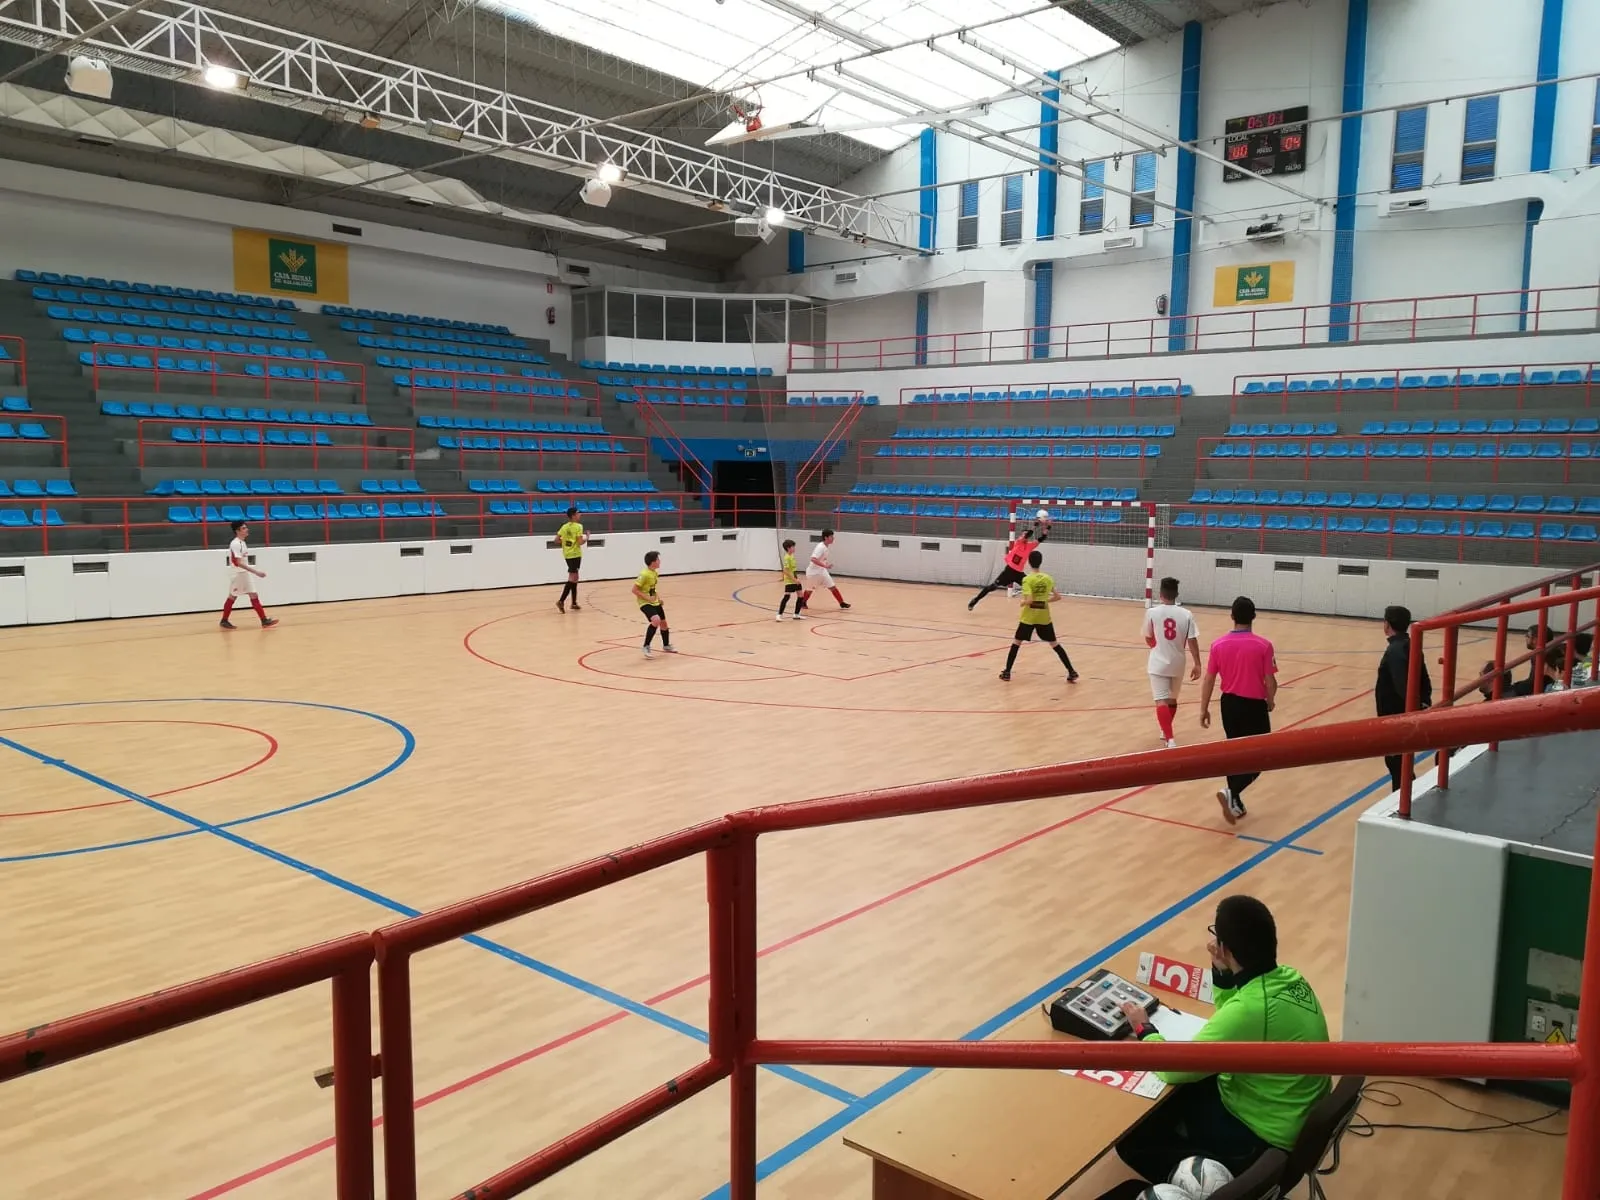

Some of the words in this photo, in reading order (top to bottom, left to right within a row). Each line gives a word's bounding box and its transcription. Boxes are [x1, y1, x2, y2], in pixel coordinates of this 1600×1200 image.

[1228, 133, 1248, 143] LOCAL
[1163, 617, 1177, 640] 8
[1154, 962, 1189, 993] 5
